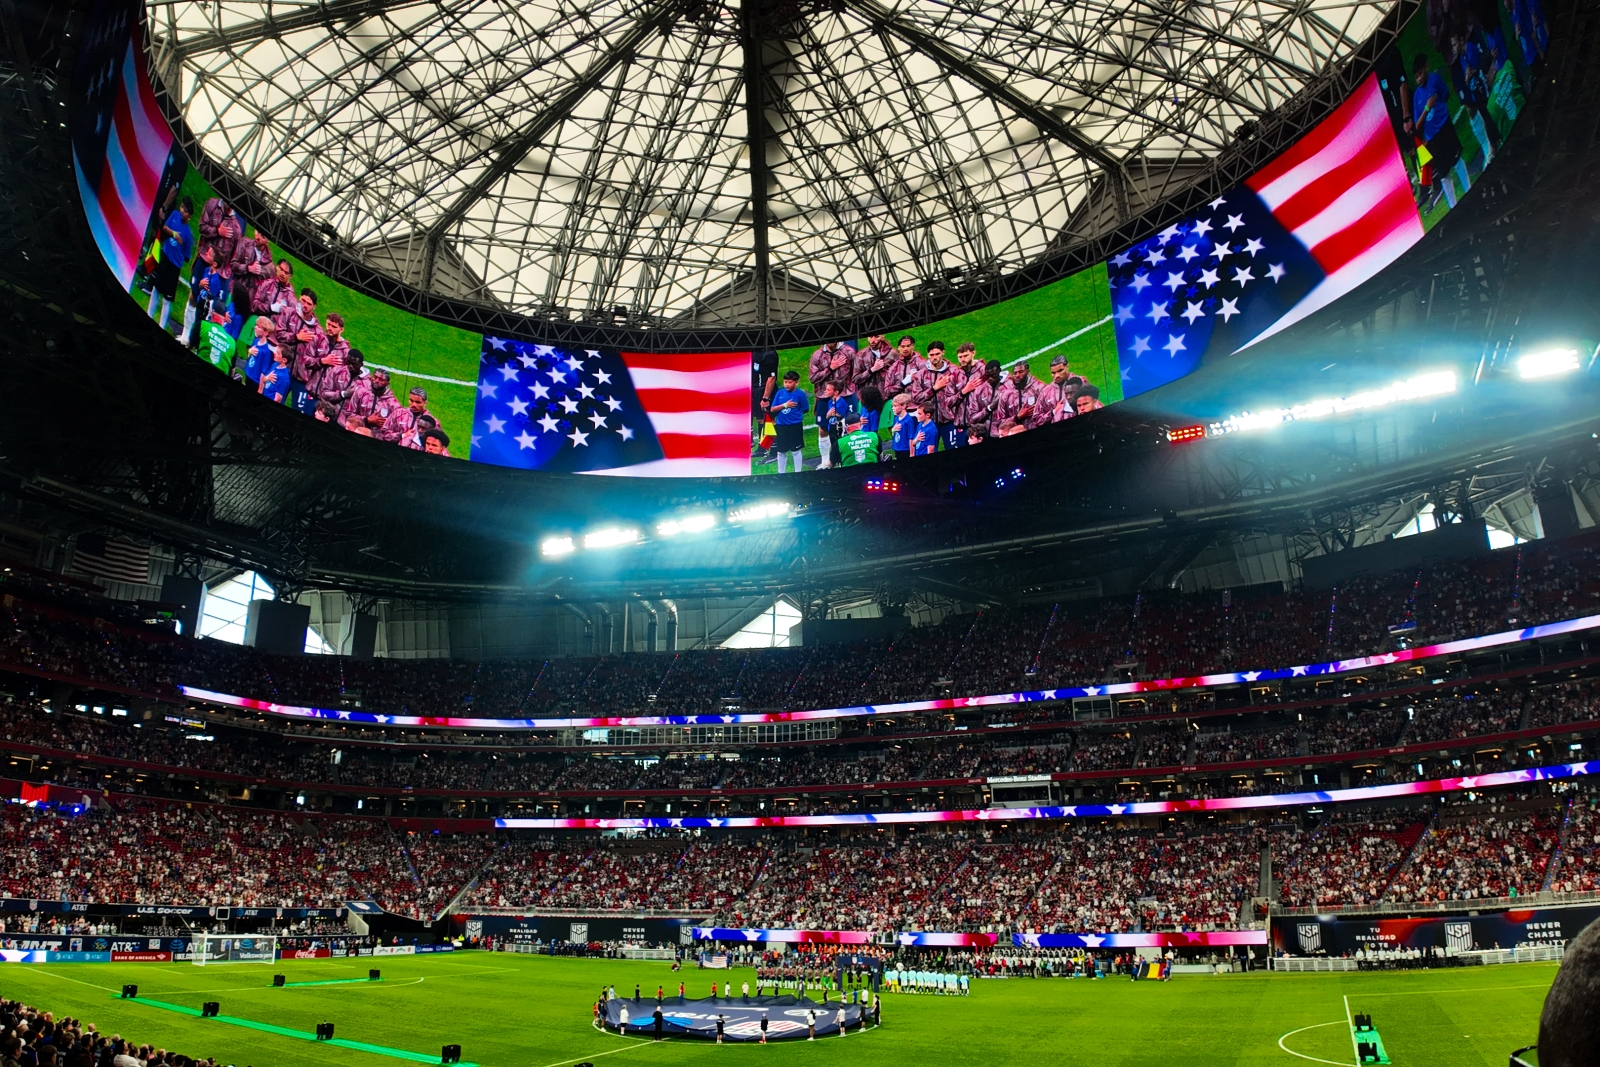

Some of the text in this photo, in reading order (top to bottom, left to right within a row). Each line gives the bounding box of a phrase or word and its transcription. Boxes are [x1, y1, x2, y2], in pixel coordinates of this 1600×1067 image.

[986, 775, 1027, 784] Mercedes-Benz
[1027, 774, 1052, 782] Stadium
[467, 921, 481, 931] USA
[571, 924, 587, 935] USA
[1526, 921, 1561, 930] NEVER
[681, 926, 692, 936] US
[1298, 925, 1318, 938] USA
[1447, 924, 1469, 938] USA
[1527, 930, 1561, 939] CHASE
[110, 942, 140, 952] AT&
[185, 942, 213, 952] ATT
[240, 952, 273, 960] Volkswagen
